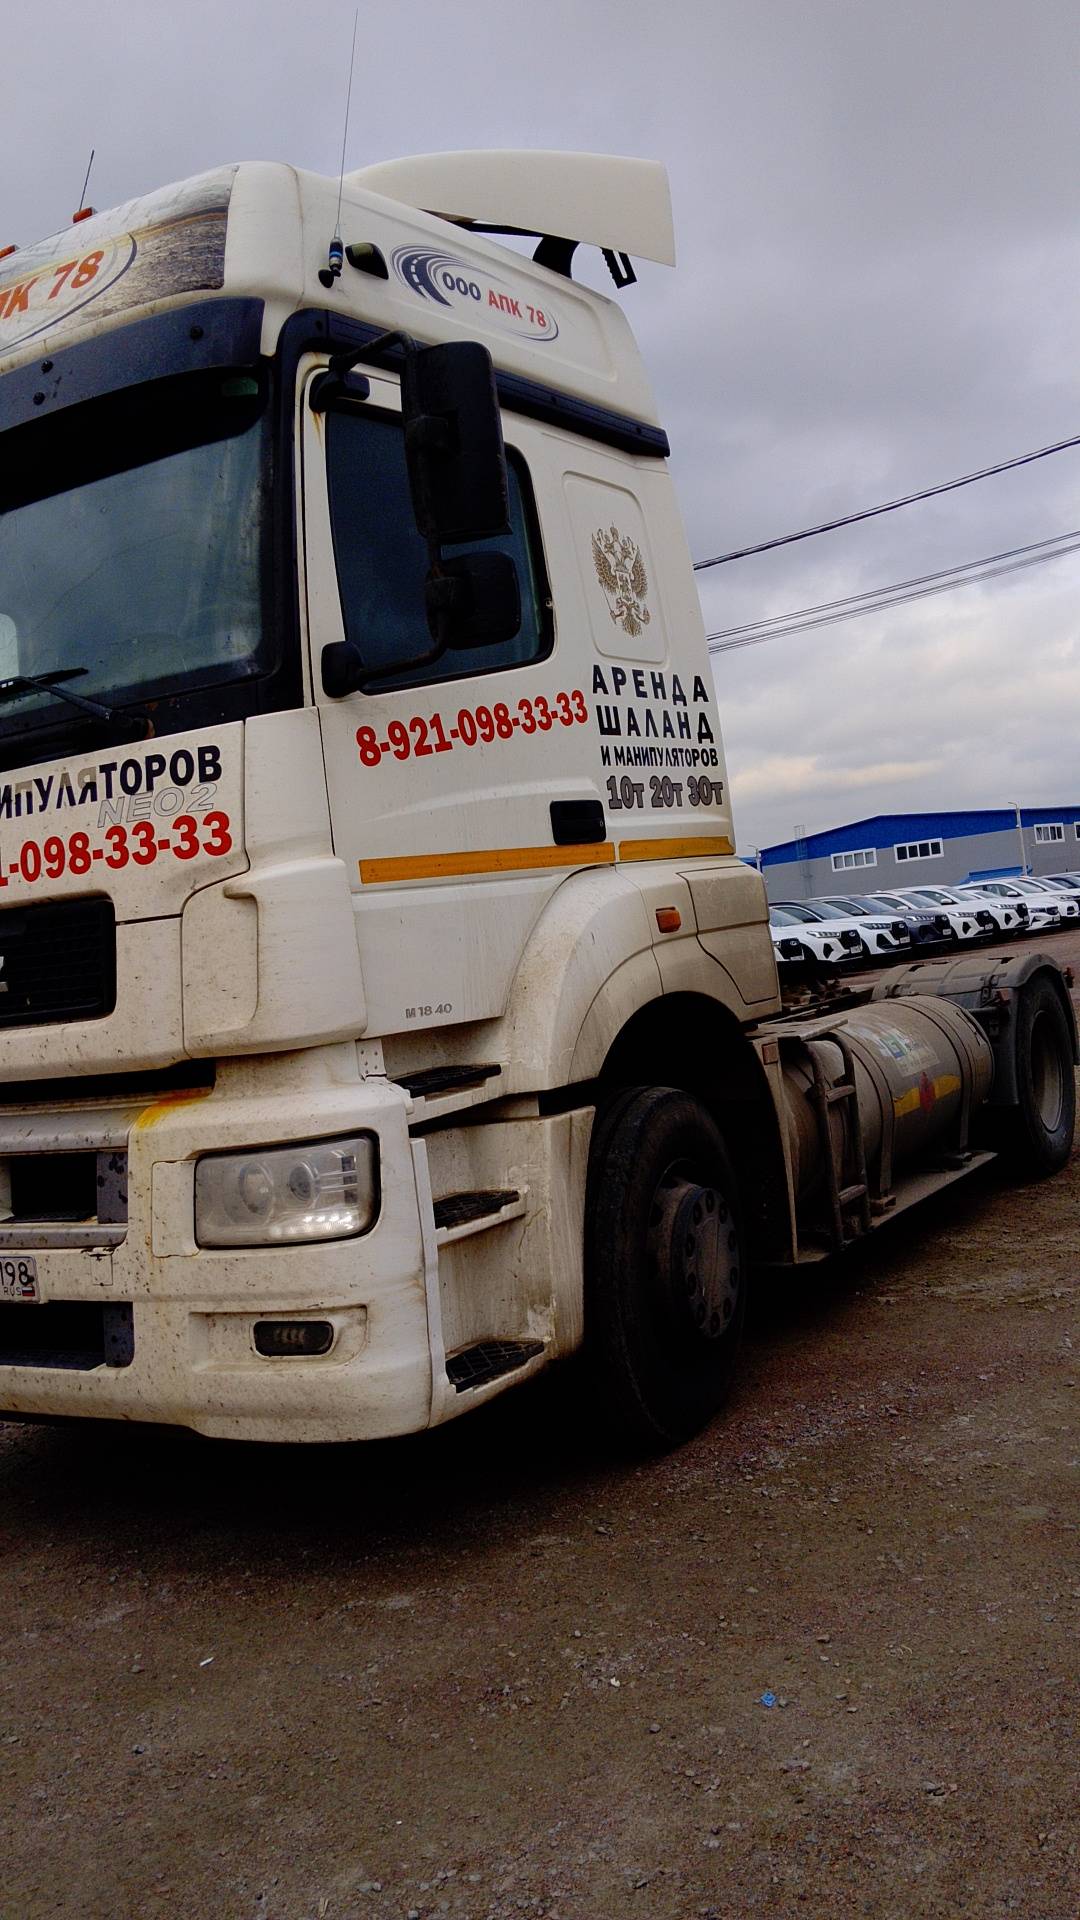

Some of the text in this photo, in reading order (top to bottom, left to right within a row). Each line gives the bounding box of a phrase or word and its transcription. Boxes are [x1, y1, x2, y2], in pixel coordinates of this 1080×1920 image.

[48, 250, 104, 300] 78
[488, 288, 523, 318] АПК
[526, 305, 547, 328] 78
[592, 664, 709, 706] АРЕНДА
[355, 689, 588, 767] 8-921-098-33-33
[596, 705, 714, 744] ШАЛАНД
[600, 745, 719, 767] И МАНИПУЛЯТОРОВ
[3, 1286, 21, 1297] RUS
